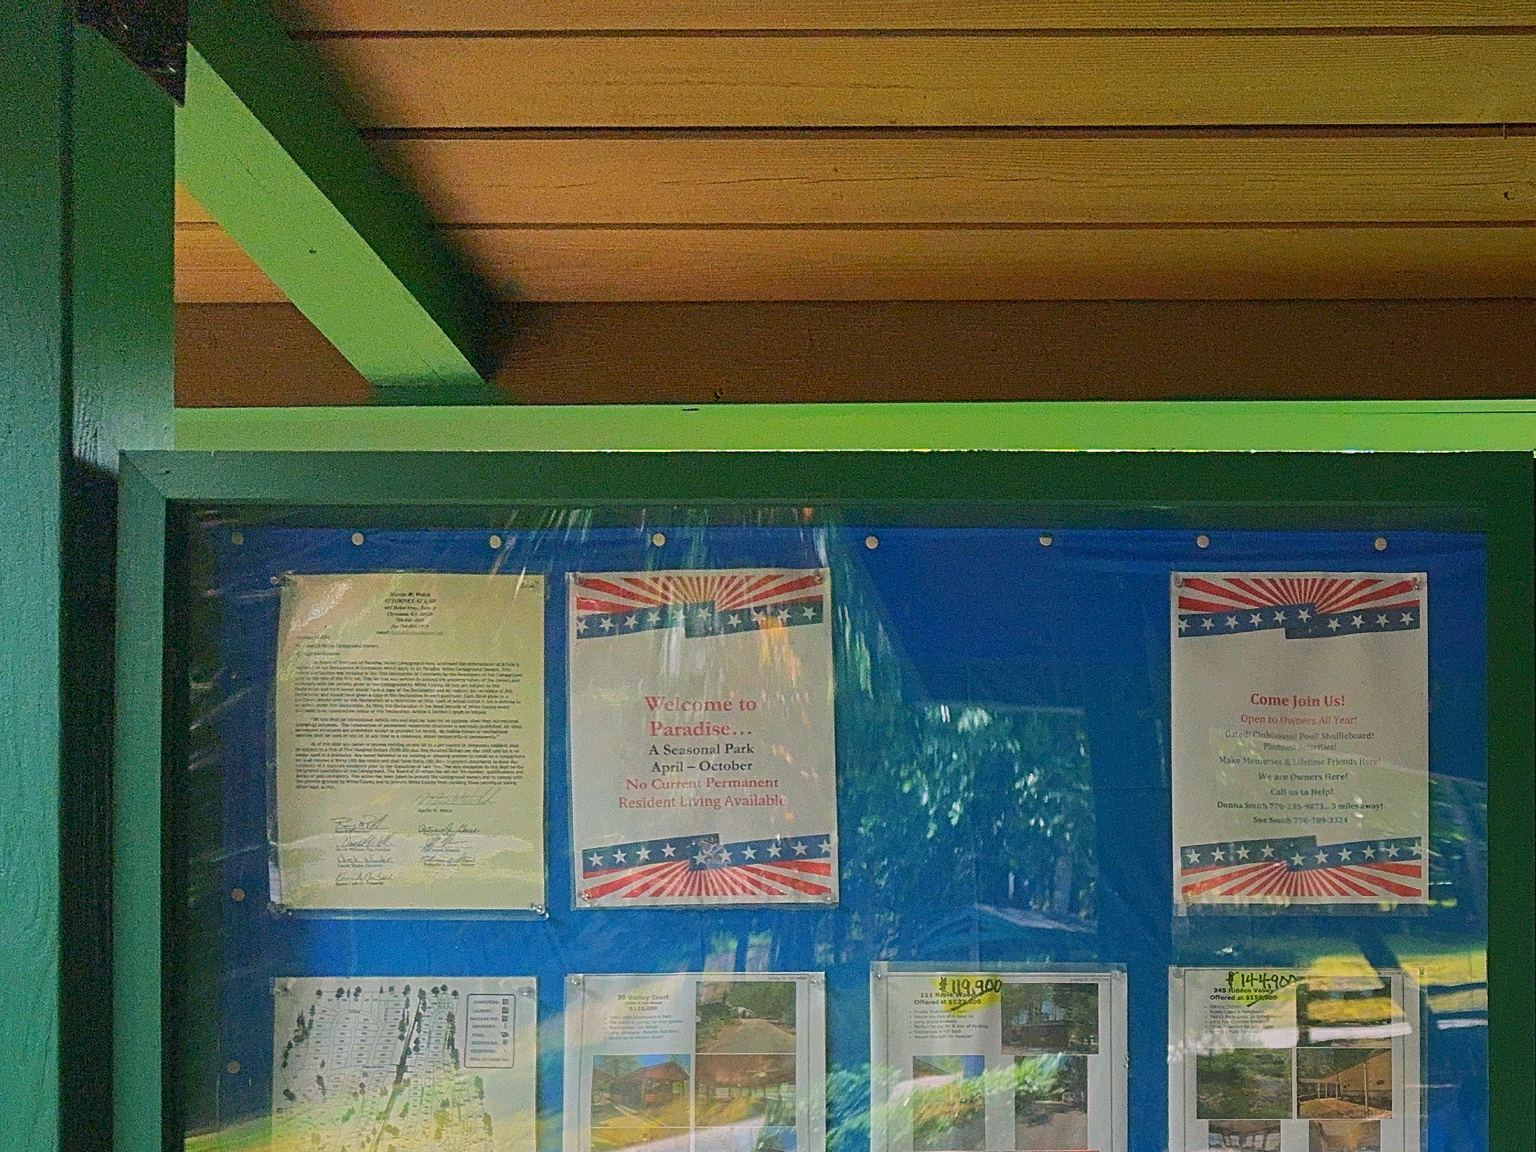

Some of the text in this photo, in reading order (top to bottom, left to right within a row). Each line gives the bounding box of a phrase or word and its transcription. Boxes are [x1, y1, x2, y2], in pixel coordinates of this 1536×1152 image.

[644, 694, 757, 711] Welcome to
[1250, 694, 1345, 708] Come Join Us!
[1241, 714, 1266, 725] Open
[1280, 716, 1316, 725] Owners
[1319, 716, 1330, 724] All
[1334, 716, 1357, 725] Year!
[649, 743, 755, 755] A Seasonal Park
[1219, 756, 1240, 764] Make
[1243, 757, 1282, 766] Memories
[1284, 758, 1291, 766] &
[651, 762, 683, 775] April
[699, 760, 752, 771] October
[1258, 772, 1272, 780] We
[626, 777, 778, 790] No Current Permanent
[1312, 788, 1334, 796] Help!
[618, 794, 788, 810] Resident Living Available
[1360, 803, 1383, 811] away!
[939, 976, 1002, 993] $119,900
